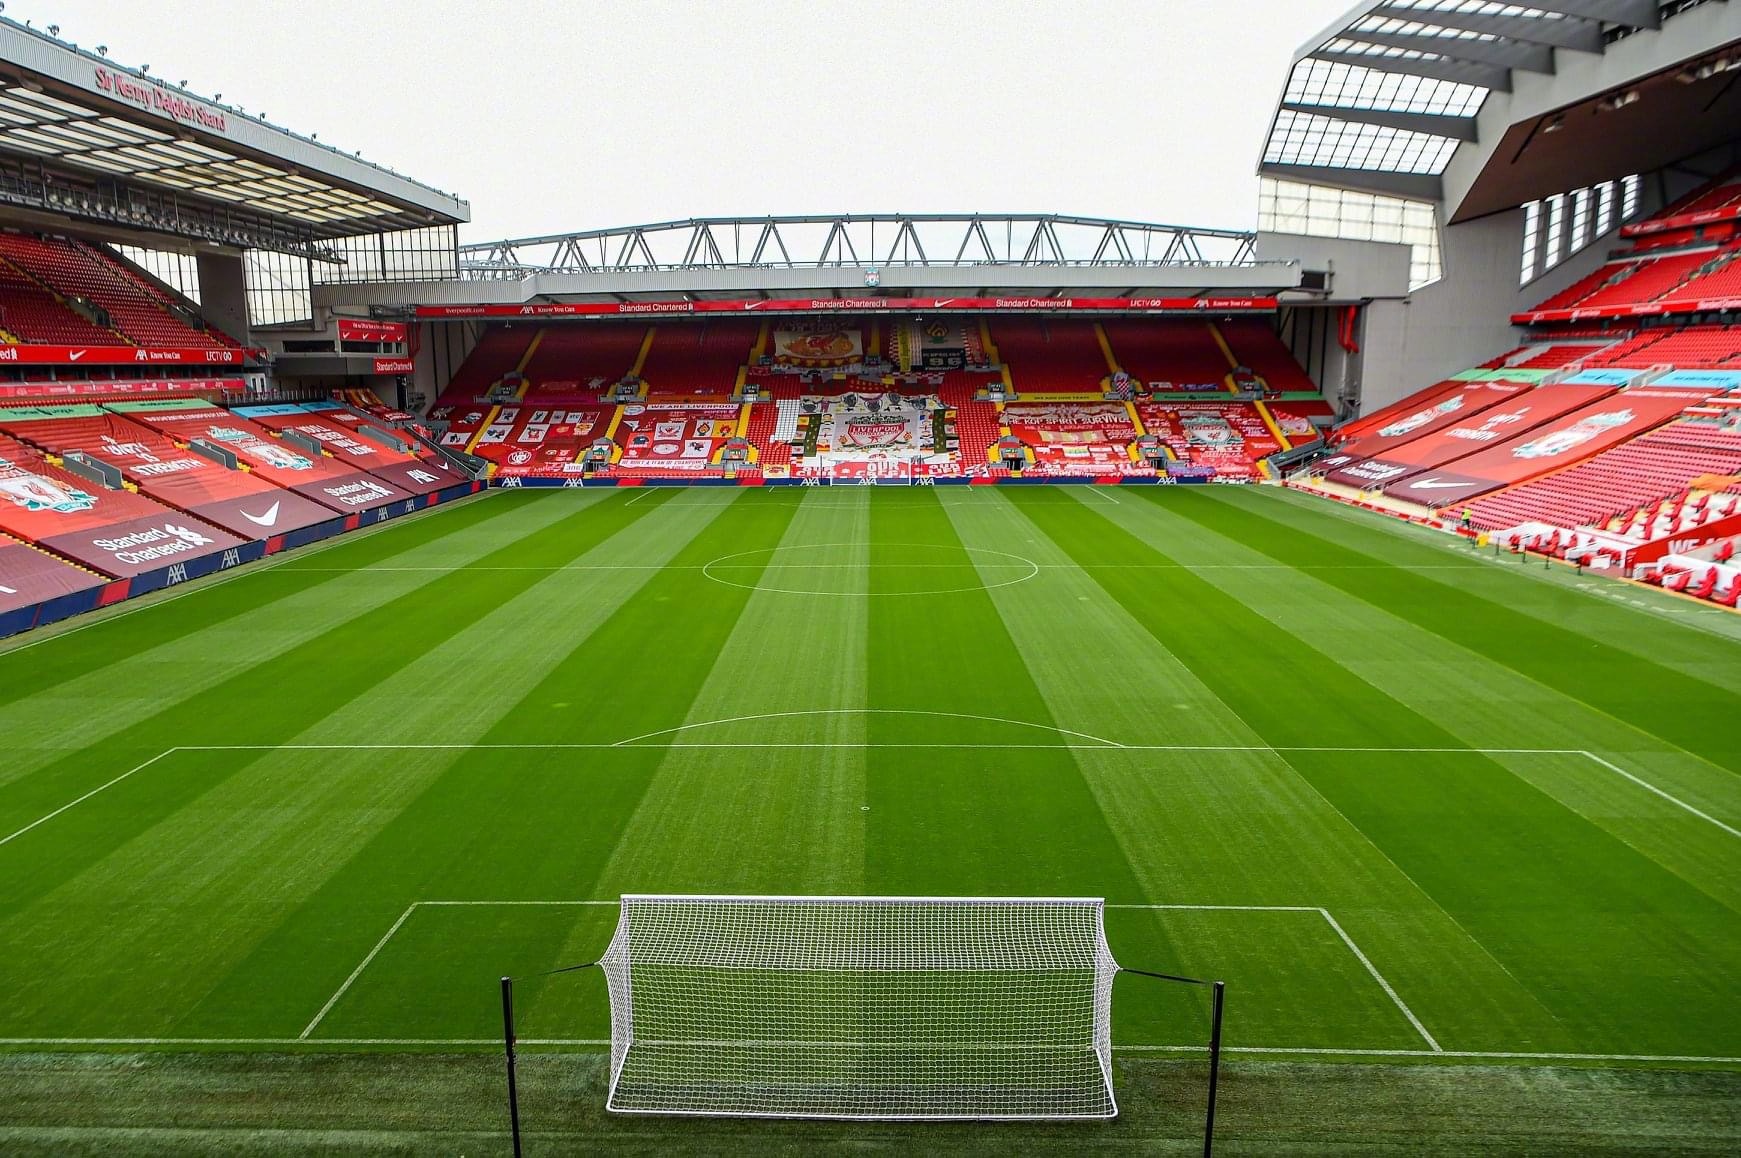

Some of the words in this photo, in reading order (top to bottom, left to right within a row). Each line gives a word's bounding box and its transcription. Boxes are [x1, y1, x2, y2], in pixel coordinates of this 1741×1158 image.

[95, 64, 113, 91] Sir
[114, 74, 152, 109] Kenny
[196, 107, 226, 131] Stand
[619, 304, 651, 313] Standard
[652, 303, 688, 312] Chartered
[812, 300, 844, 309] Standard
[846, 299, 881, 308] Chartered
[996, 299, 1029, 308] Standard
[1030, 299, 1066, 308] Chartered
[519, 305, 535, 315] AXA
[501, 476, 522, 488] AXA
[563, 477, 584, 488] AXA
[800, 477, 820, 486] AXA
[858, 477, 877, 486] AXA
[914, 477, 935, 486] AXA
[1156, 476, 1177, 485] AXA
[323, 482, 366, 498] Standard
[339, 490, 384, 506] Chartered
[405, 498, 415, 512] AXA
[377, 507, 389, 520] AXA
[93, 527, 170, 551] Standard
[115, 539, 195, 564] Chartered
[220, 548, 241, 569] AXA
[167, 562, 188, 585] AXA
